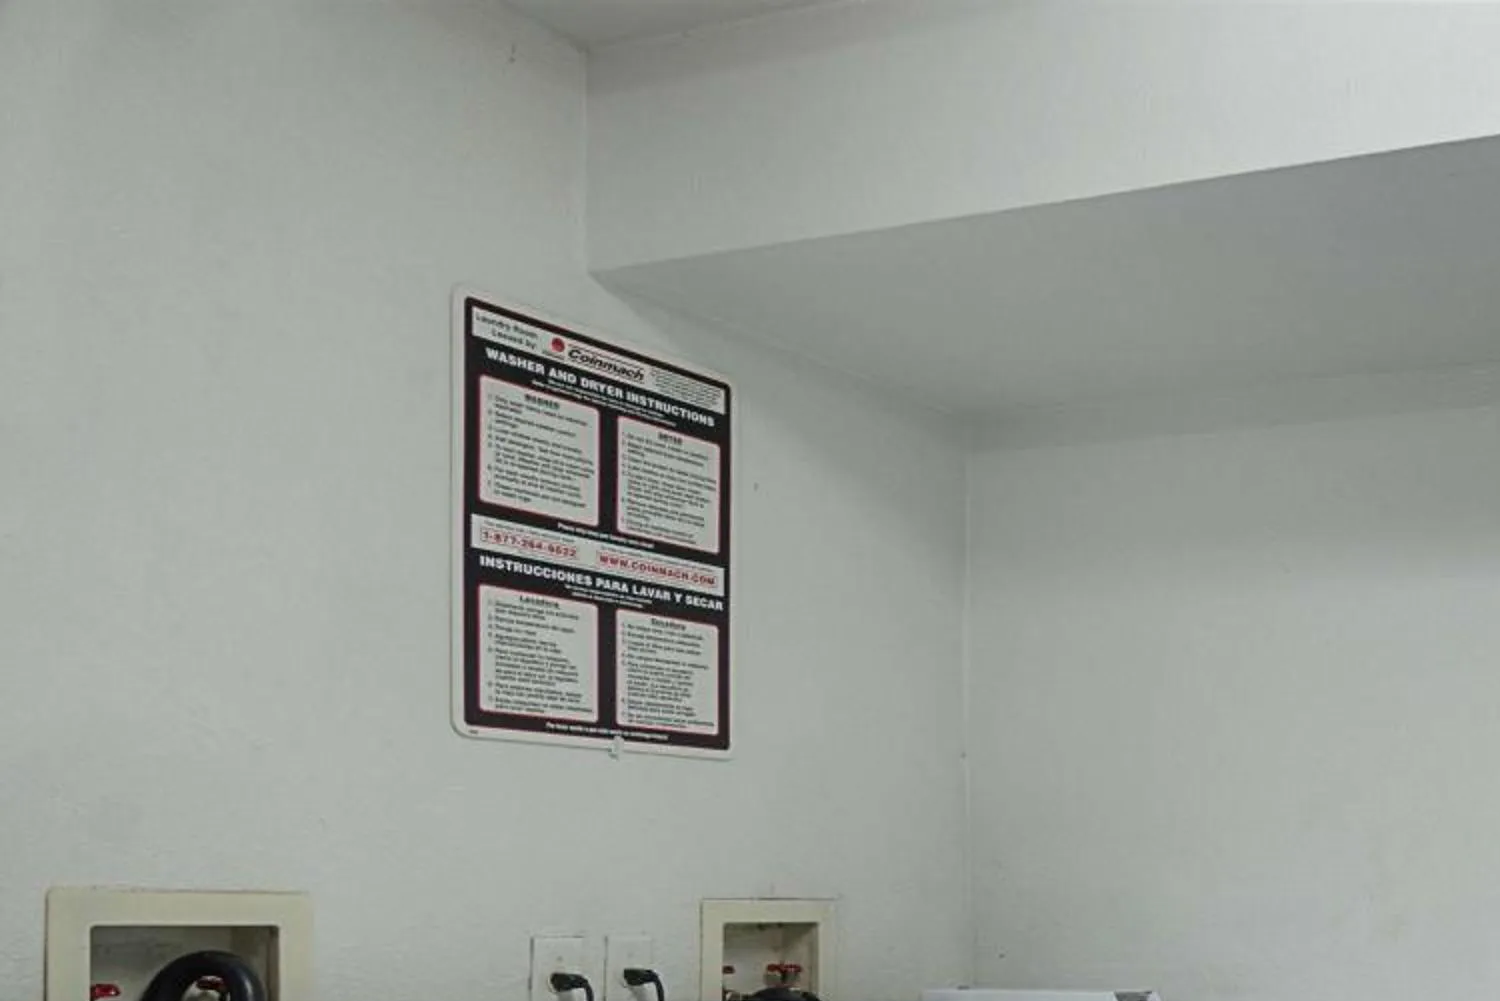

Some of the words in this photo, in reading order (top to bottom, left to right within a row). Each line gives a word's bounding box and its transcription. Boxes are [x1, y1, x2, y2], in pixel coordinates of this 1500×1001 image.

[569, 347, 643, 380] Coinmach
[486, 347, 544, 374] WASHER
[549, 366, 576, 384] AND
[581, 376, 622, 398] DRYER
[627, 391, 714, 426] INSTRUCTIONS
[480, 555, 591, 585] INSTRUCCIONES
[596, 577, 628, 592] PARA
[633, 584, 670, 600] LAVAR
[675, 593, 682, 602] Y
[686, 595, 723, 610] SECAR
[600, 554, 714, 585] WWW.COINMACH.COM
